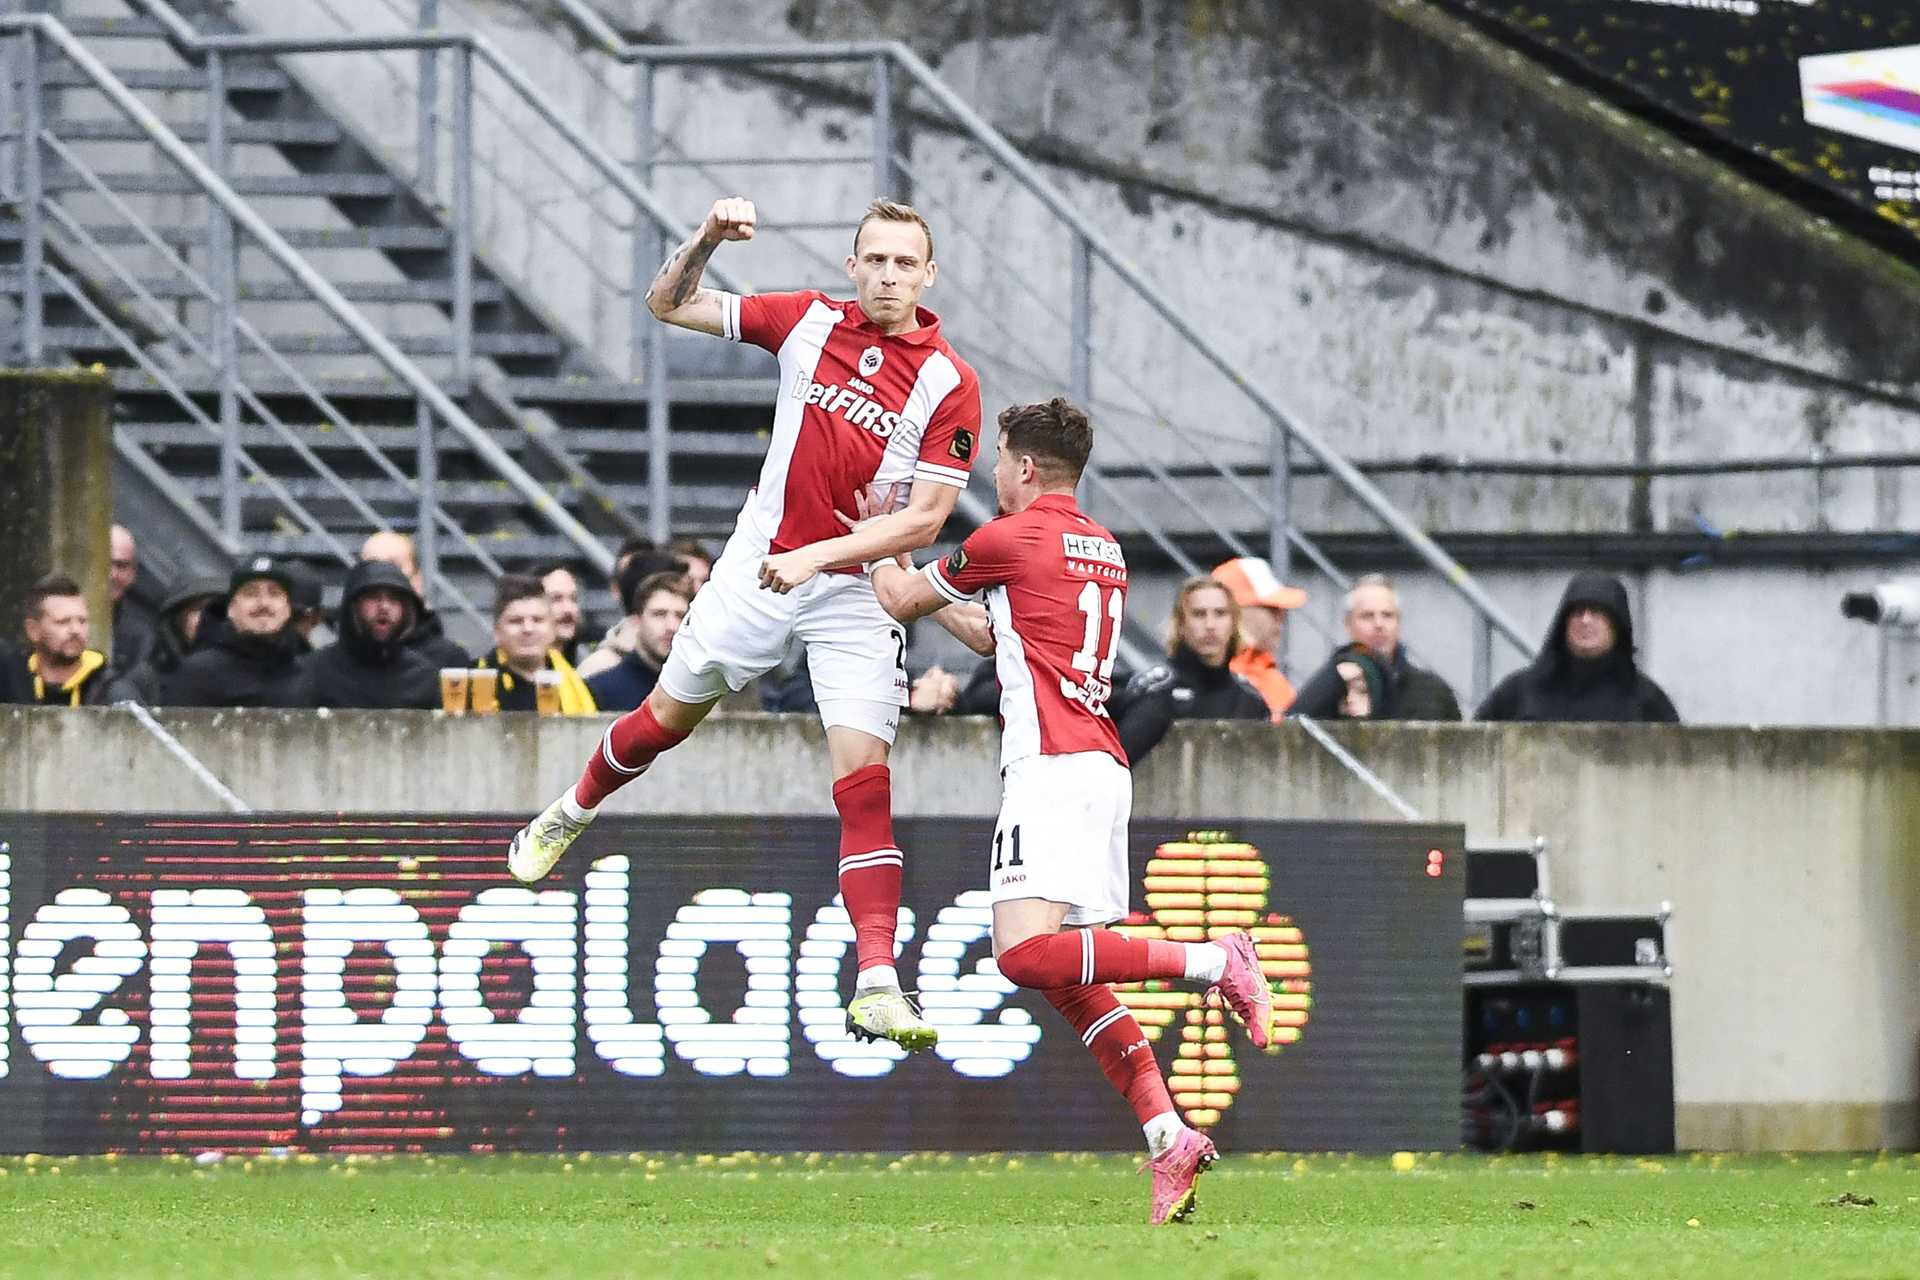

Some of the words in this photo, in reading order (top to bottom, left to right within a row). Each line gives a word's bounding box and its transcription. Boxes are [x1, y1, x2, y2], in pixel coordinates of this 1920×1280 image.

[847, 376, 875, 395] JAKO
[1071, 580, 1123, 680] 11
[994, 824, 1024, 871] 11
[1000, 874, 1027, 886] JAKO
[0, 842, 1042, 1125] enpalace
